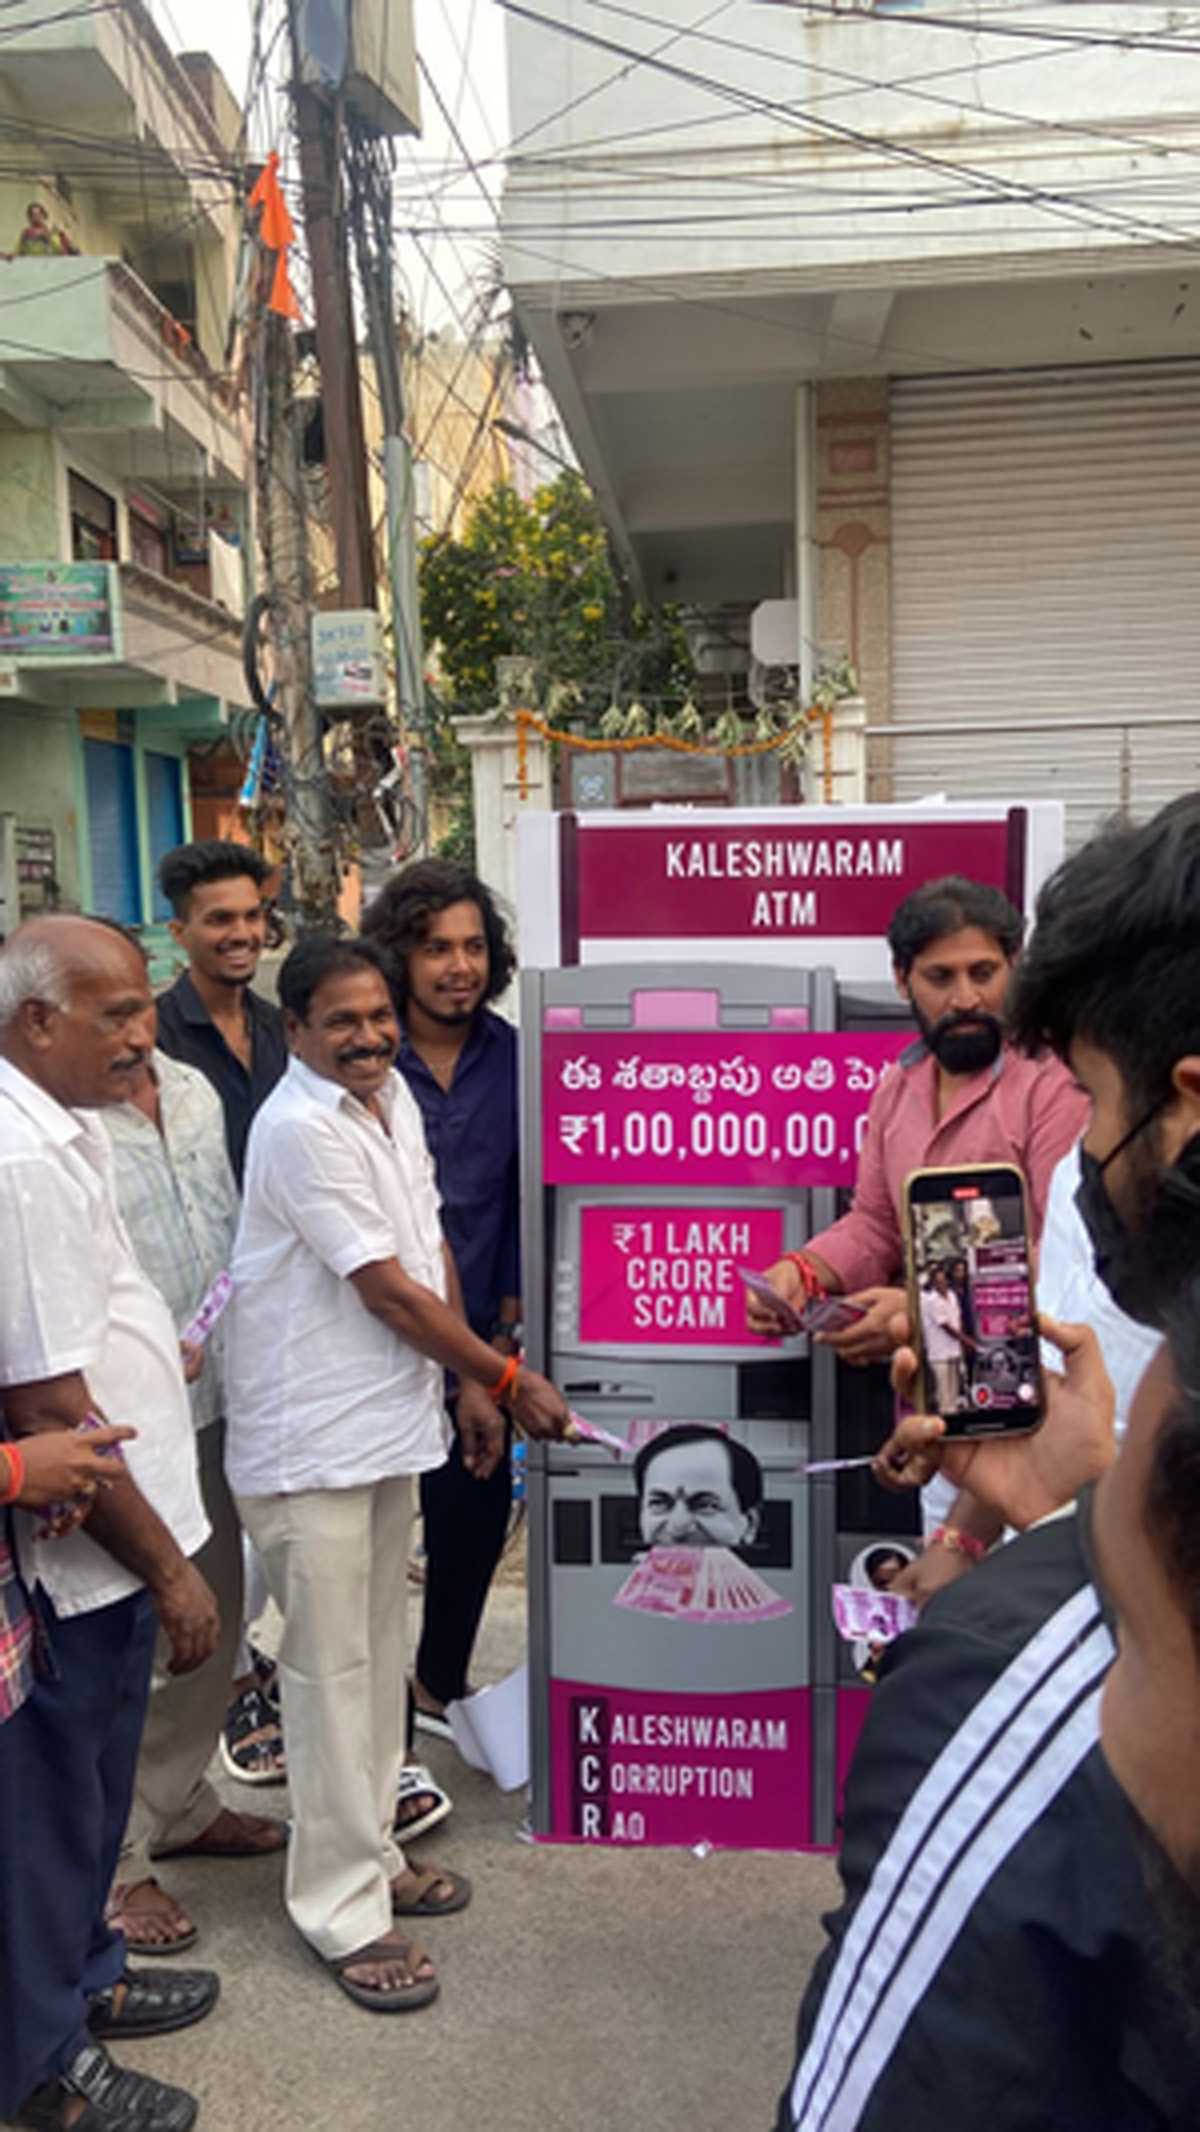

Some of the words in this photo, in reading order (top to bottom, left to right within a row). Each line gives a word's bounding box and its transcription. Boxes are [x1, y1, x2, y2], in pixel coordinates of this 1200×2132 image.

[666, 839, 903, 878] KALESHWARAM
[752, 891, 817, 927] ATM
[560, 1055, 602, 1090] ఈ
[772, 1056, 836, 1091] అతి
[666, 1221, 750, 1256] LAKH
[627, 1256, 734, 1292] CRORE
[634, 1294, 726, 1329] SCAM
